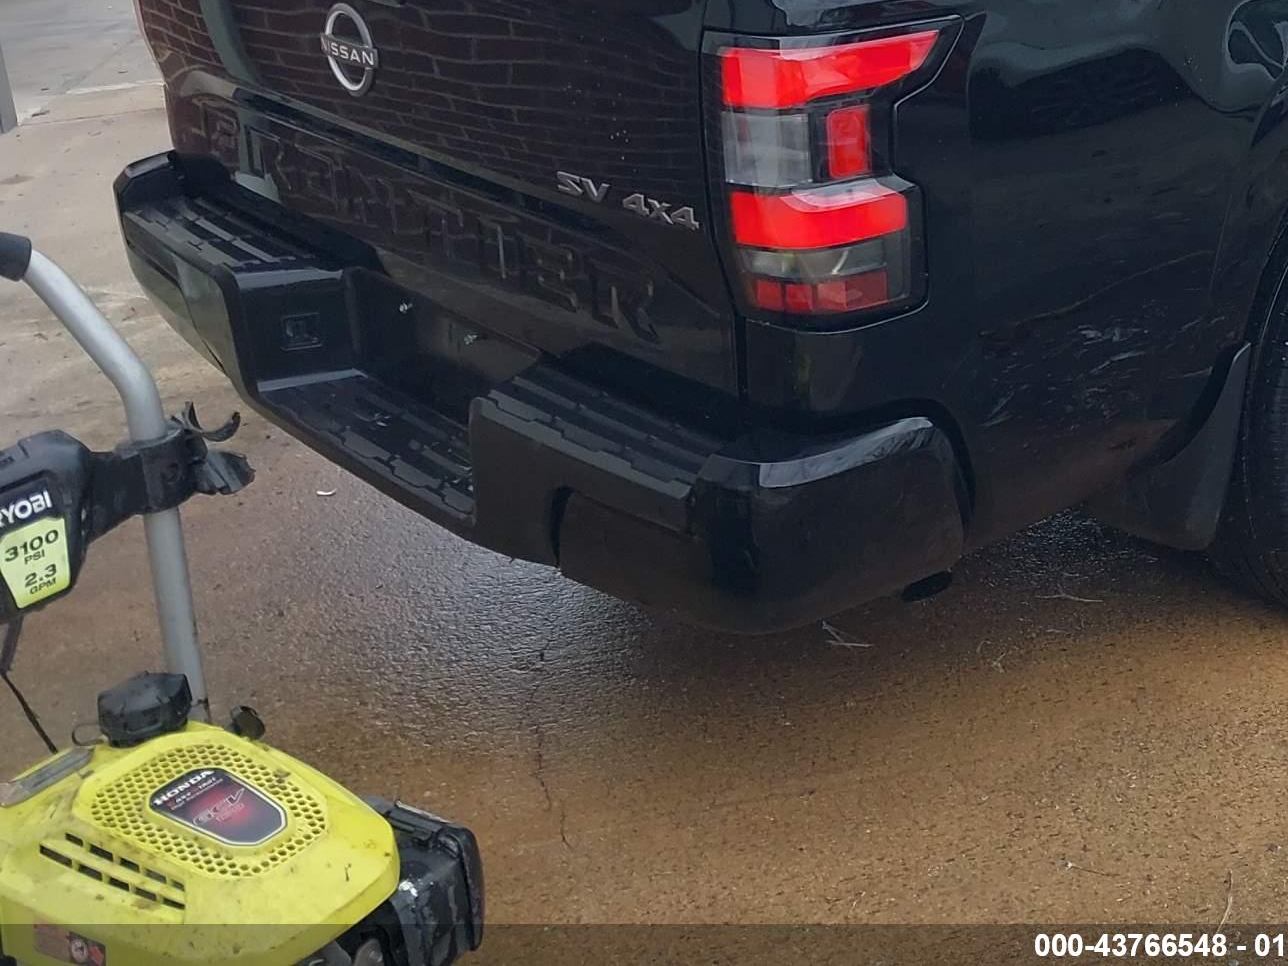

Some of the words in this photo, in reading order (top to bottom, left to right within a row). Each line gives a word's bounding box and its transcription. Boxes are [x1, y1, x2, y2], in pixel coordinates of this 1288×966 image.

[320, 36, 374, 66] NISSAN
[557, 171, 610, 202] SV
[4, 529, 59, 562] 3100
[24, 549, 46, 565] PSI
[24, 564, 57, 588] 2.3
[29, 577, 57, 595] GPM
[152, 770, 215, 806] HONDA
